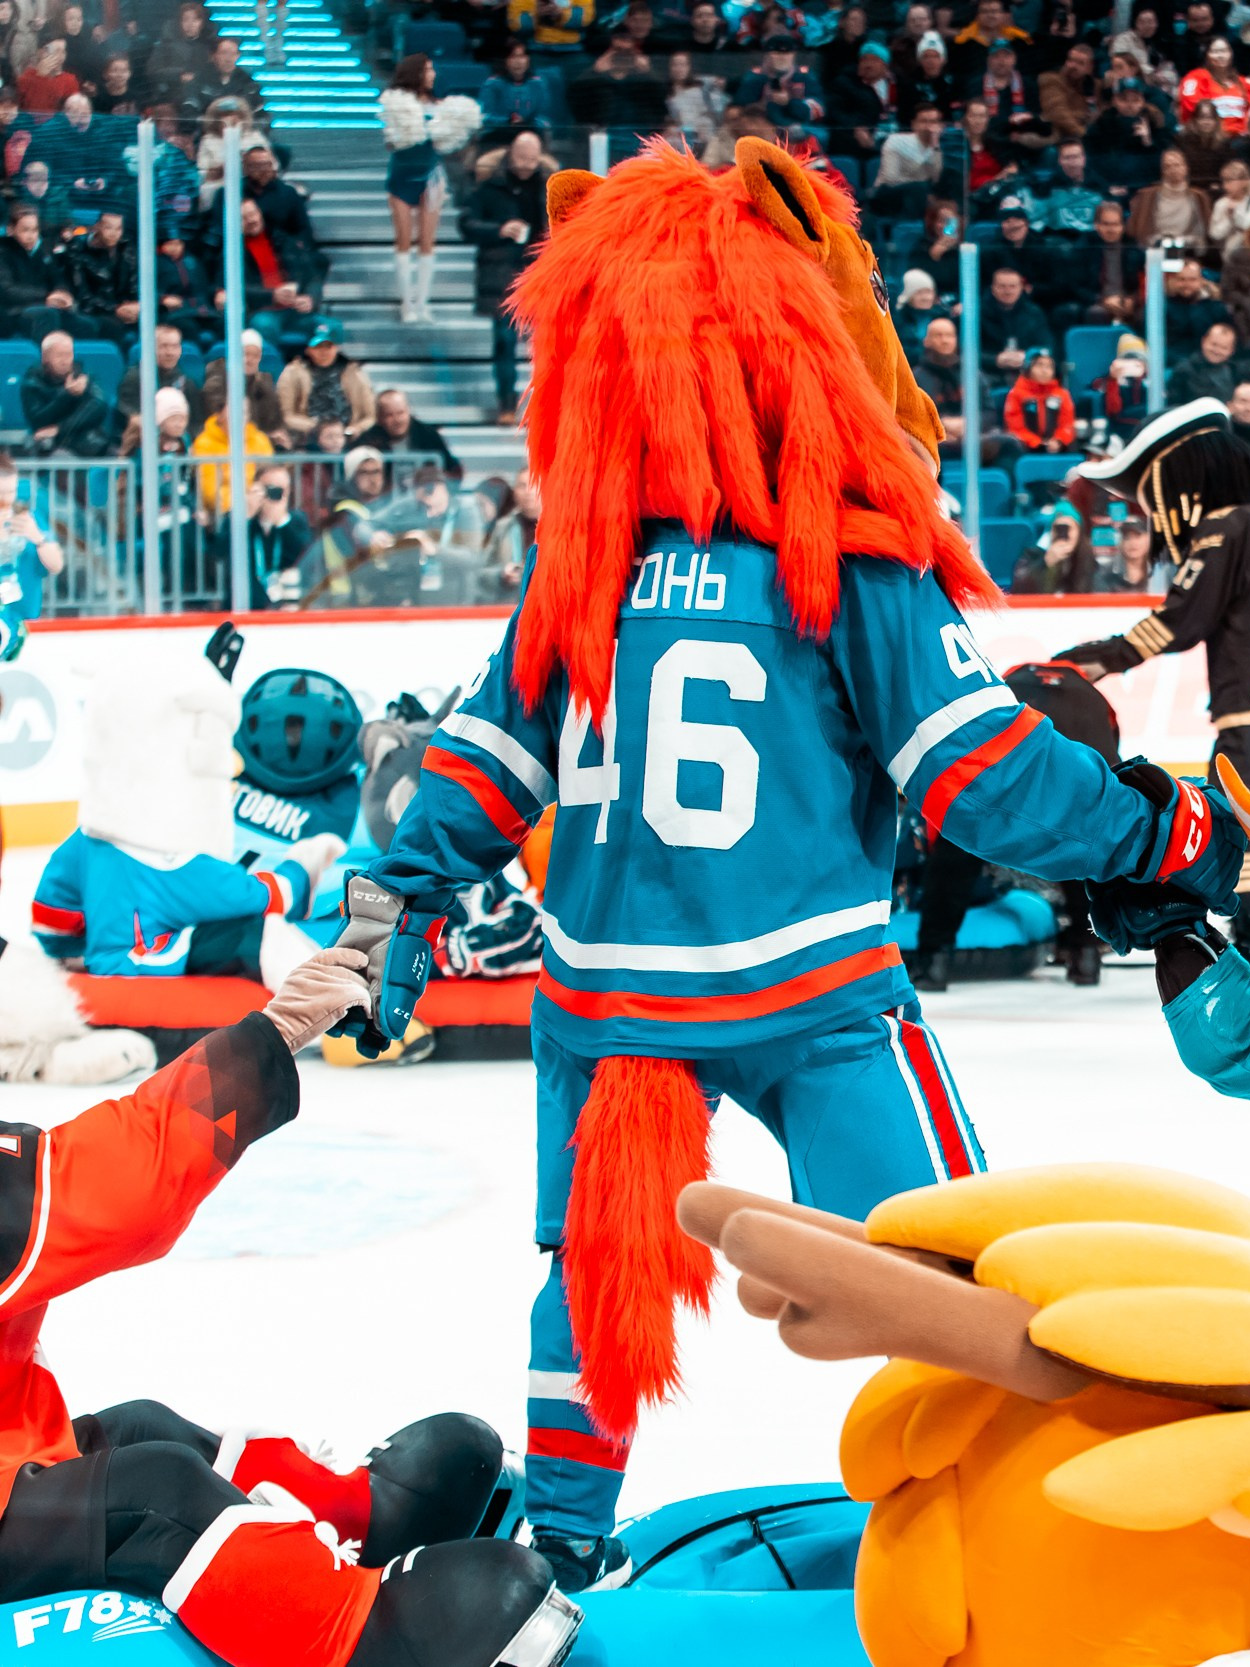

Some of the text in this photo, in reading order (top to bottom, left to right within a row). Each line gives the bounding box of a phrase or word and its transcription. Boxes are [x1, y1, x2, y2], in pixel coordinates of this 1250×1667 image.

[632, 552, 726, 610] ОНЬ
[559, 639, 767, 850] 46
[353, 890, 390, 904] CCM
[13, 1591, 125, 1648] F78
